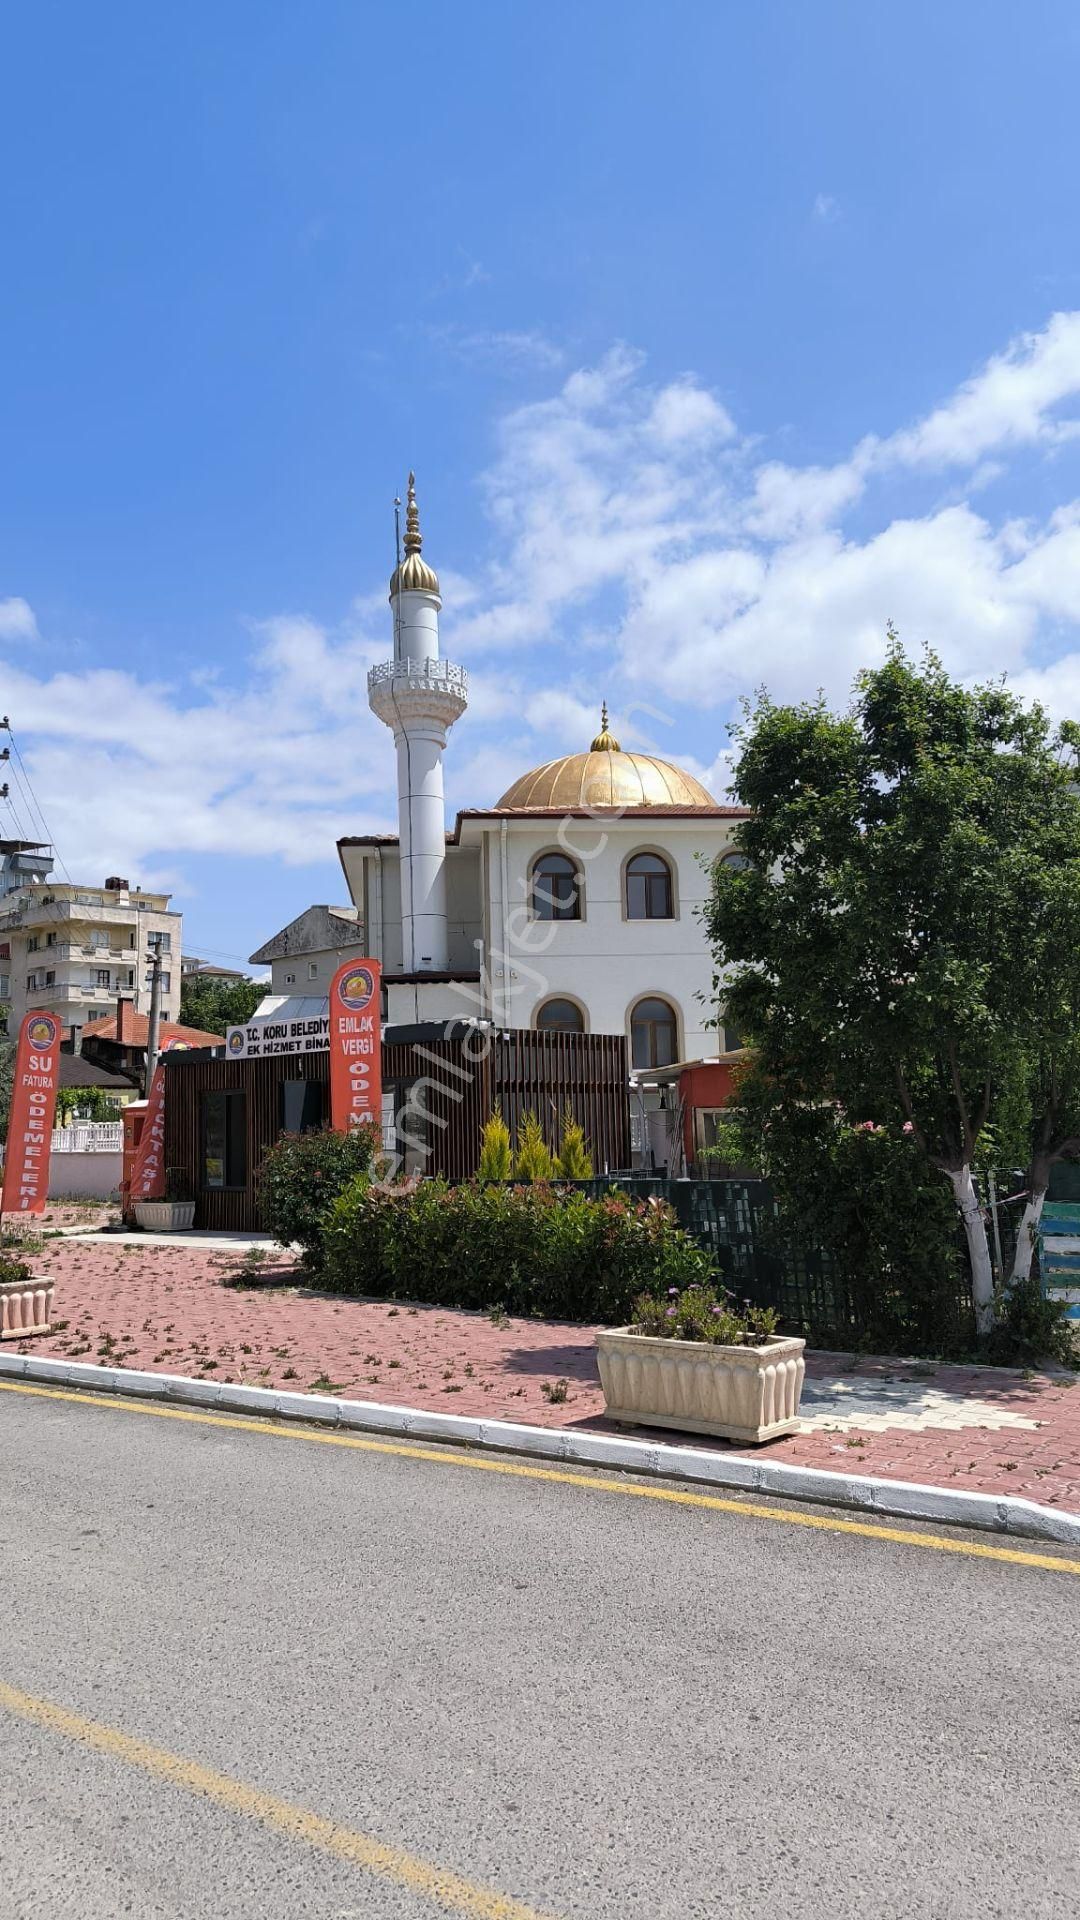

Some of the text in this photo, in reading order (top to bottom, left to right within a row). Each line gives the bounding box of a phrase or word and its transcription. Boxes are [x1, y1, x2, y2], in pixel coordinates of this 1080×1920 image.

[246, 1017, 331, 1042] T.C. KORU BELEDİY
[338, 1015, 374, 1034] EMLAK
[247, 1044, 260, 1056] EK
[263, 1040, 302, 1054] HİZMET
[341, 1034, 374, 1056] VERGİ
[28, 1055, 52, 1072] SU
[22, 1074, 53, 1089] FATURA
[20, 1091, 46, 1209] ÖDEMELERİ
